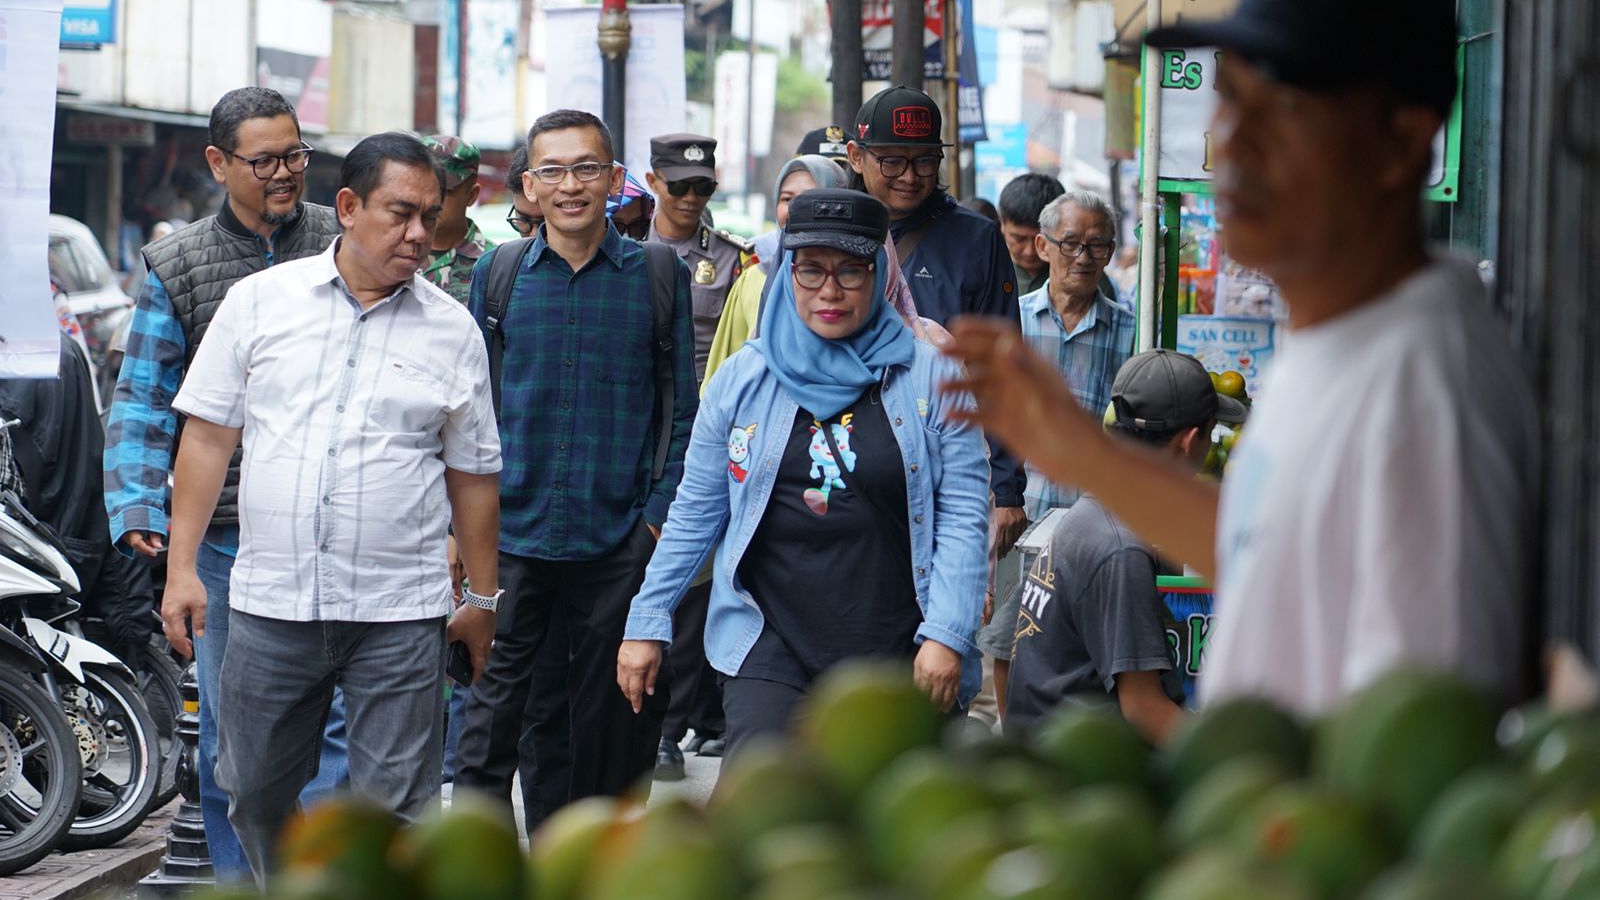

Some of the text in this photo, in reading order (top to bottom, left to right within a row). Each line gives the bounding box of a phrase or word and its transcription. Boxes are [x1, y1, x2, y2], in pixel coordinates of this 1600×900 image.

[63, 19, 99, 35] VISA
[1160, 49, 1202, 90] Es
[1189, 328, 1258, 343] SAN CELL
